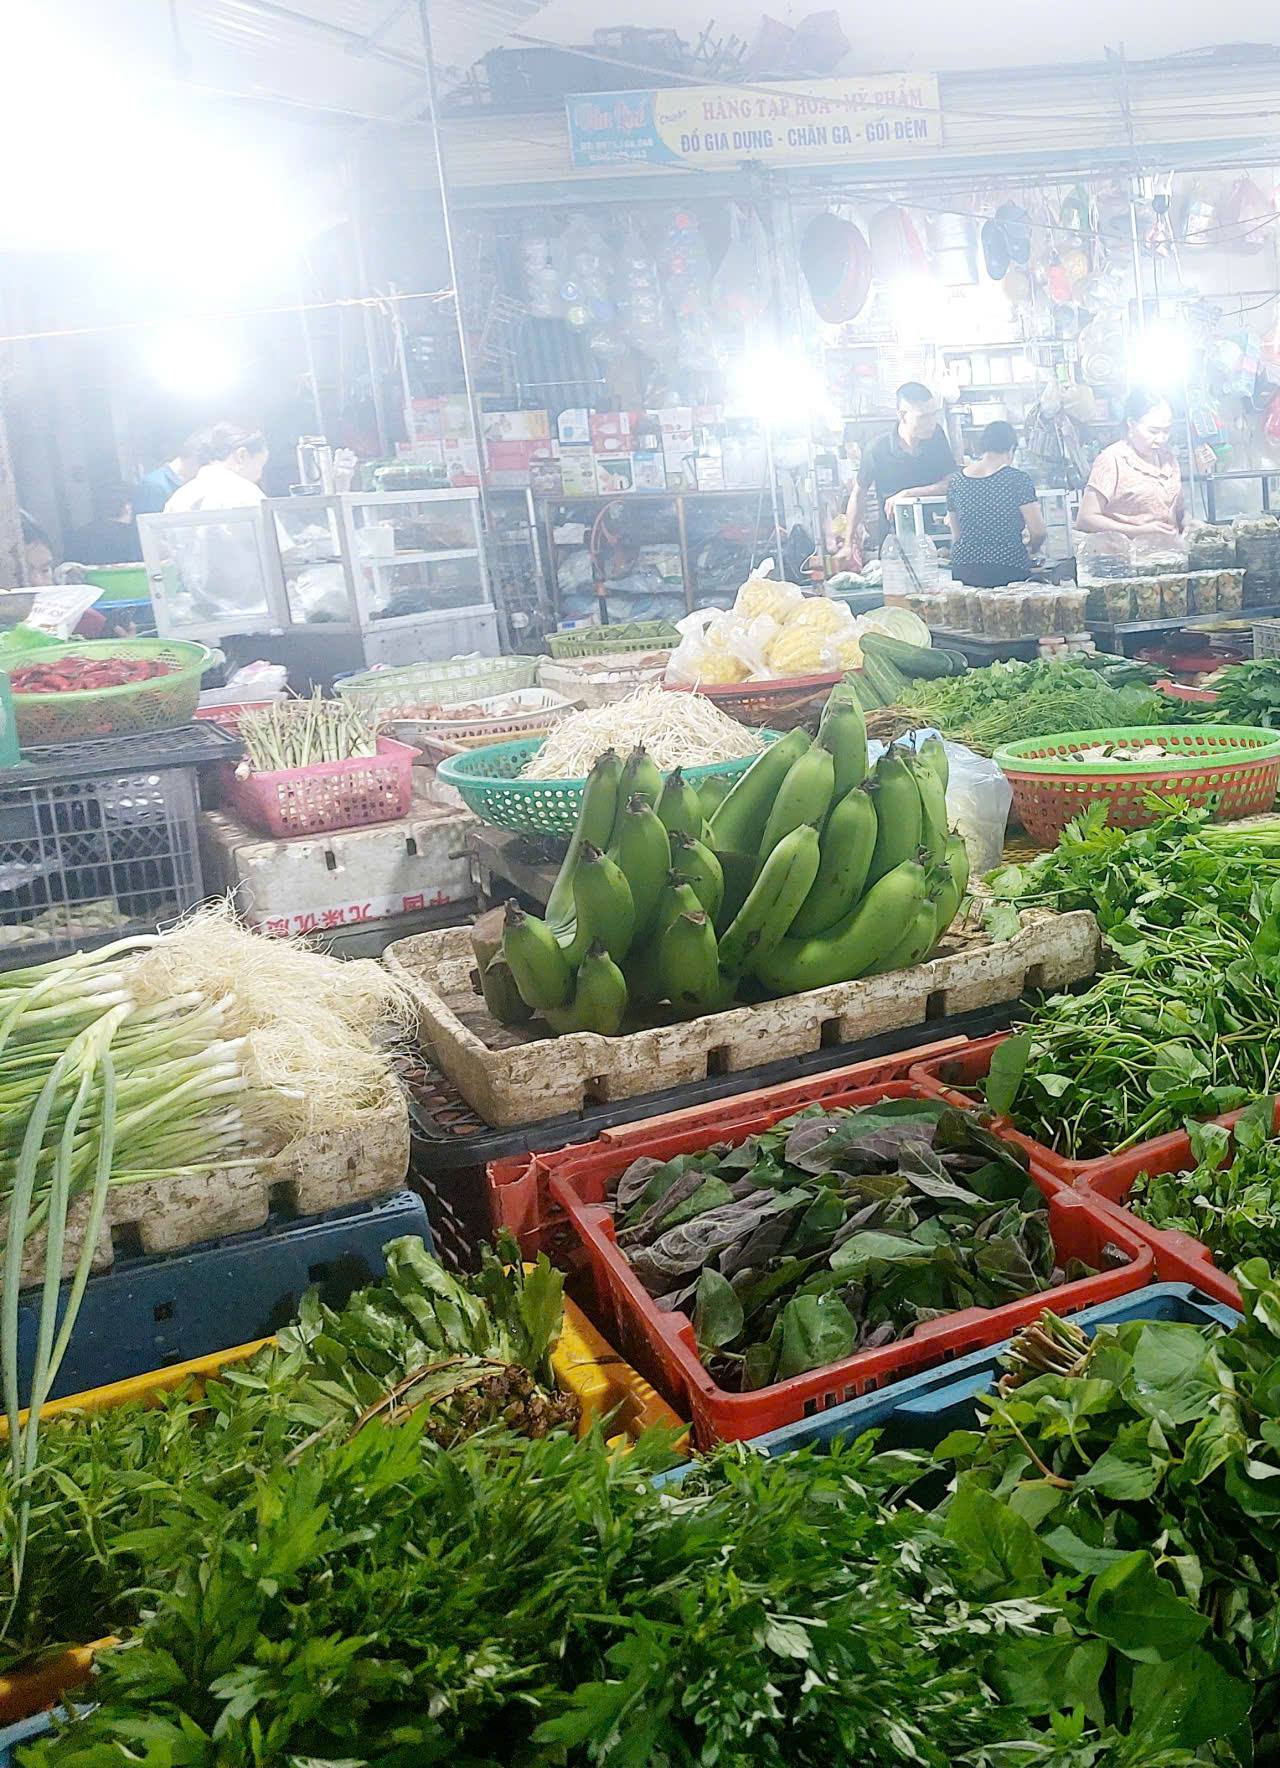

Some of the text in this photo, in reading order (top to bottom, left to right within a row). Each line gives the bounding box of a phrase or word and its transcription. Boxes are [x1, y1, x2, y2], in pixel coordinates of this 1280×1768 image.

[703, 96, 752, 120] HÀNG
[756, 98, 789, 120] TẠP
[704, 133, 729, 151] GIA
[733, 129, 773, 153] DỤNG
[832, 125, 852, 144] GA
[866, 115, 890, 143] GỐI
[894, 116, 928, 143] ĐỆM
